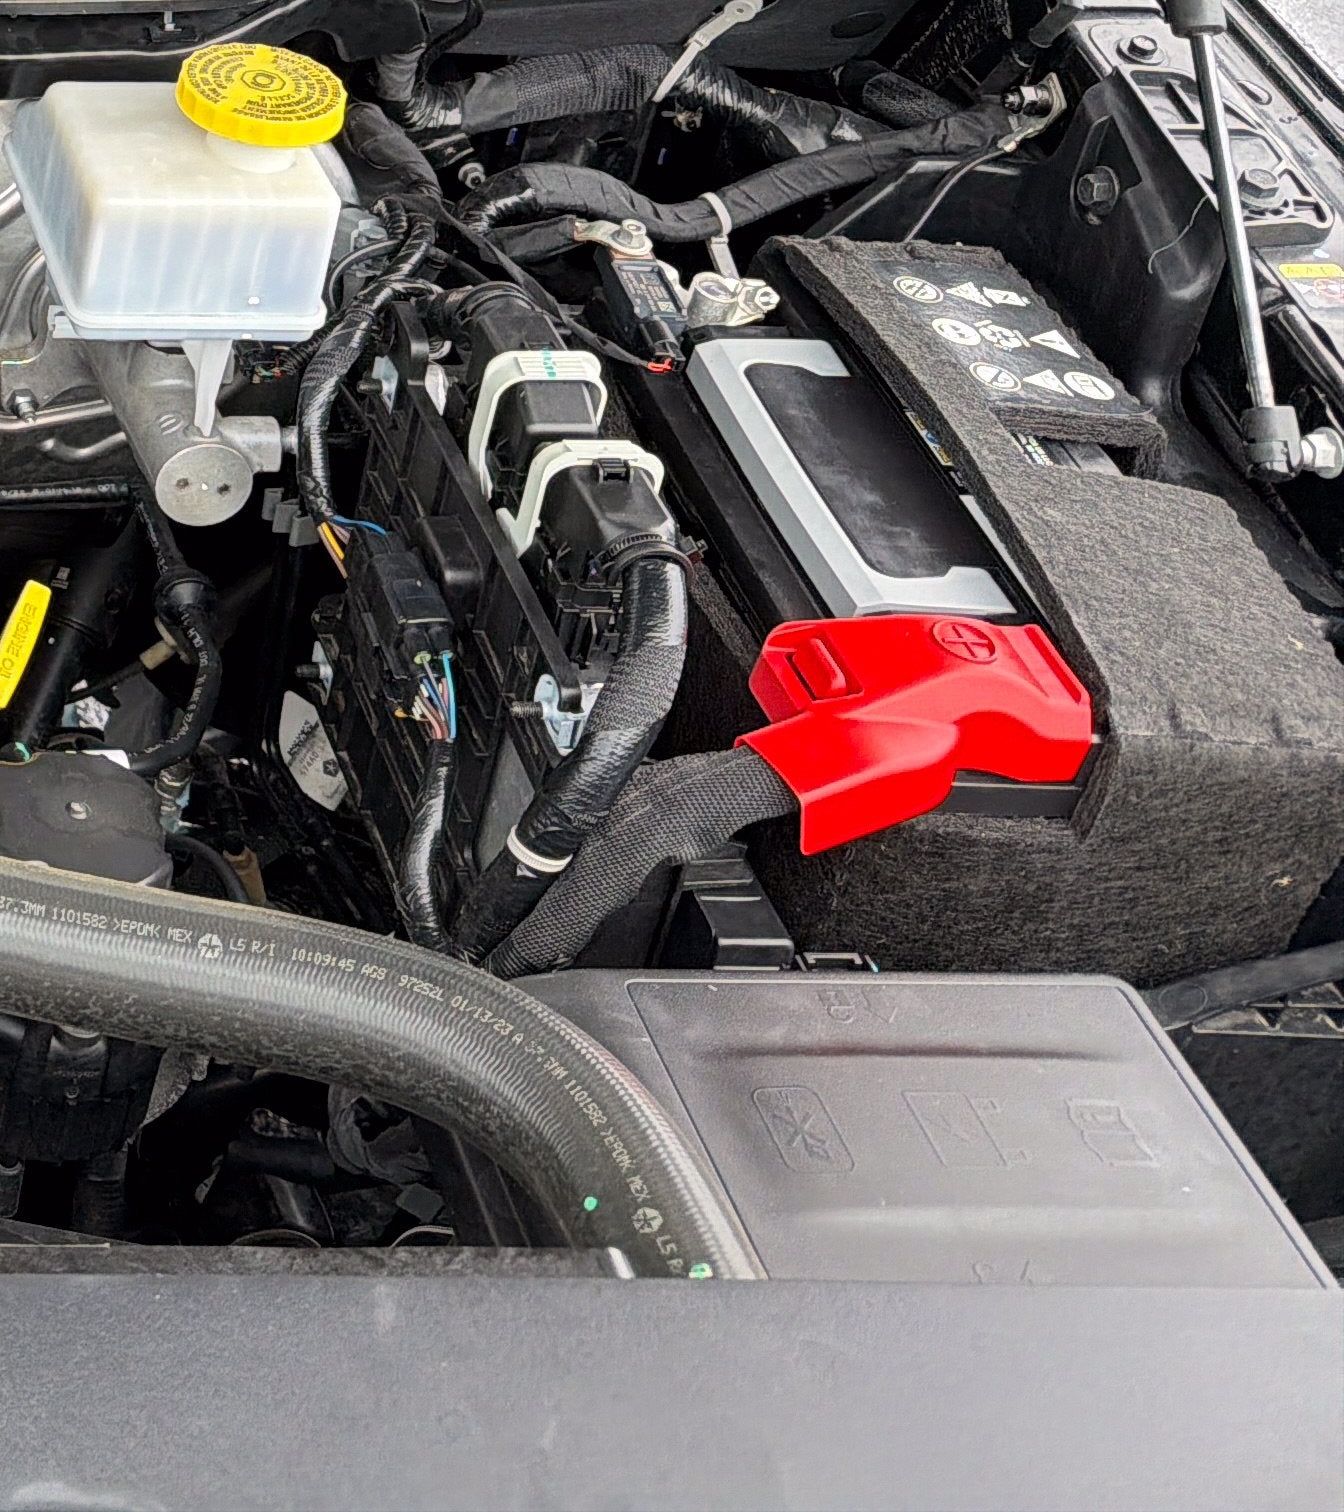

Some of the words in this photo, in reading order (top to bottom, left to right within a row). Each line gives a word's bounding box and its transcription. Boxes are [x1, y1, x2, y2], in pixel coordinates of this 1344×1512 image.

[51, 906, 109, 930] 1101582
[167, 927, 193, 944] MEX
[291, 947, 357, 973] 10:09:45
[398, 974, 445, 1002] 97252L
[450, 994, 515, 1036] 01/13/23
